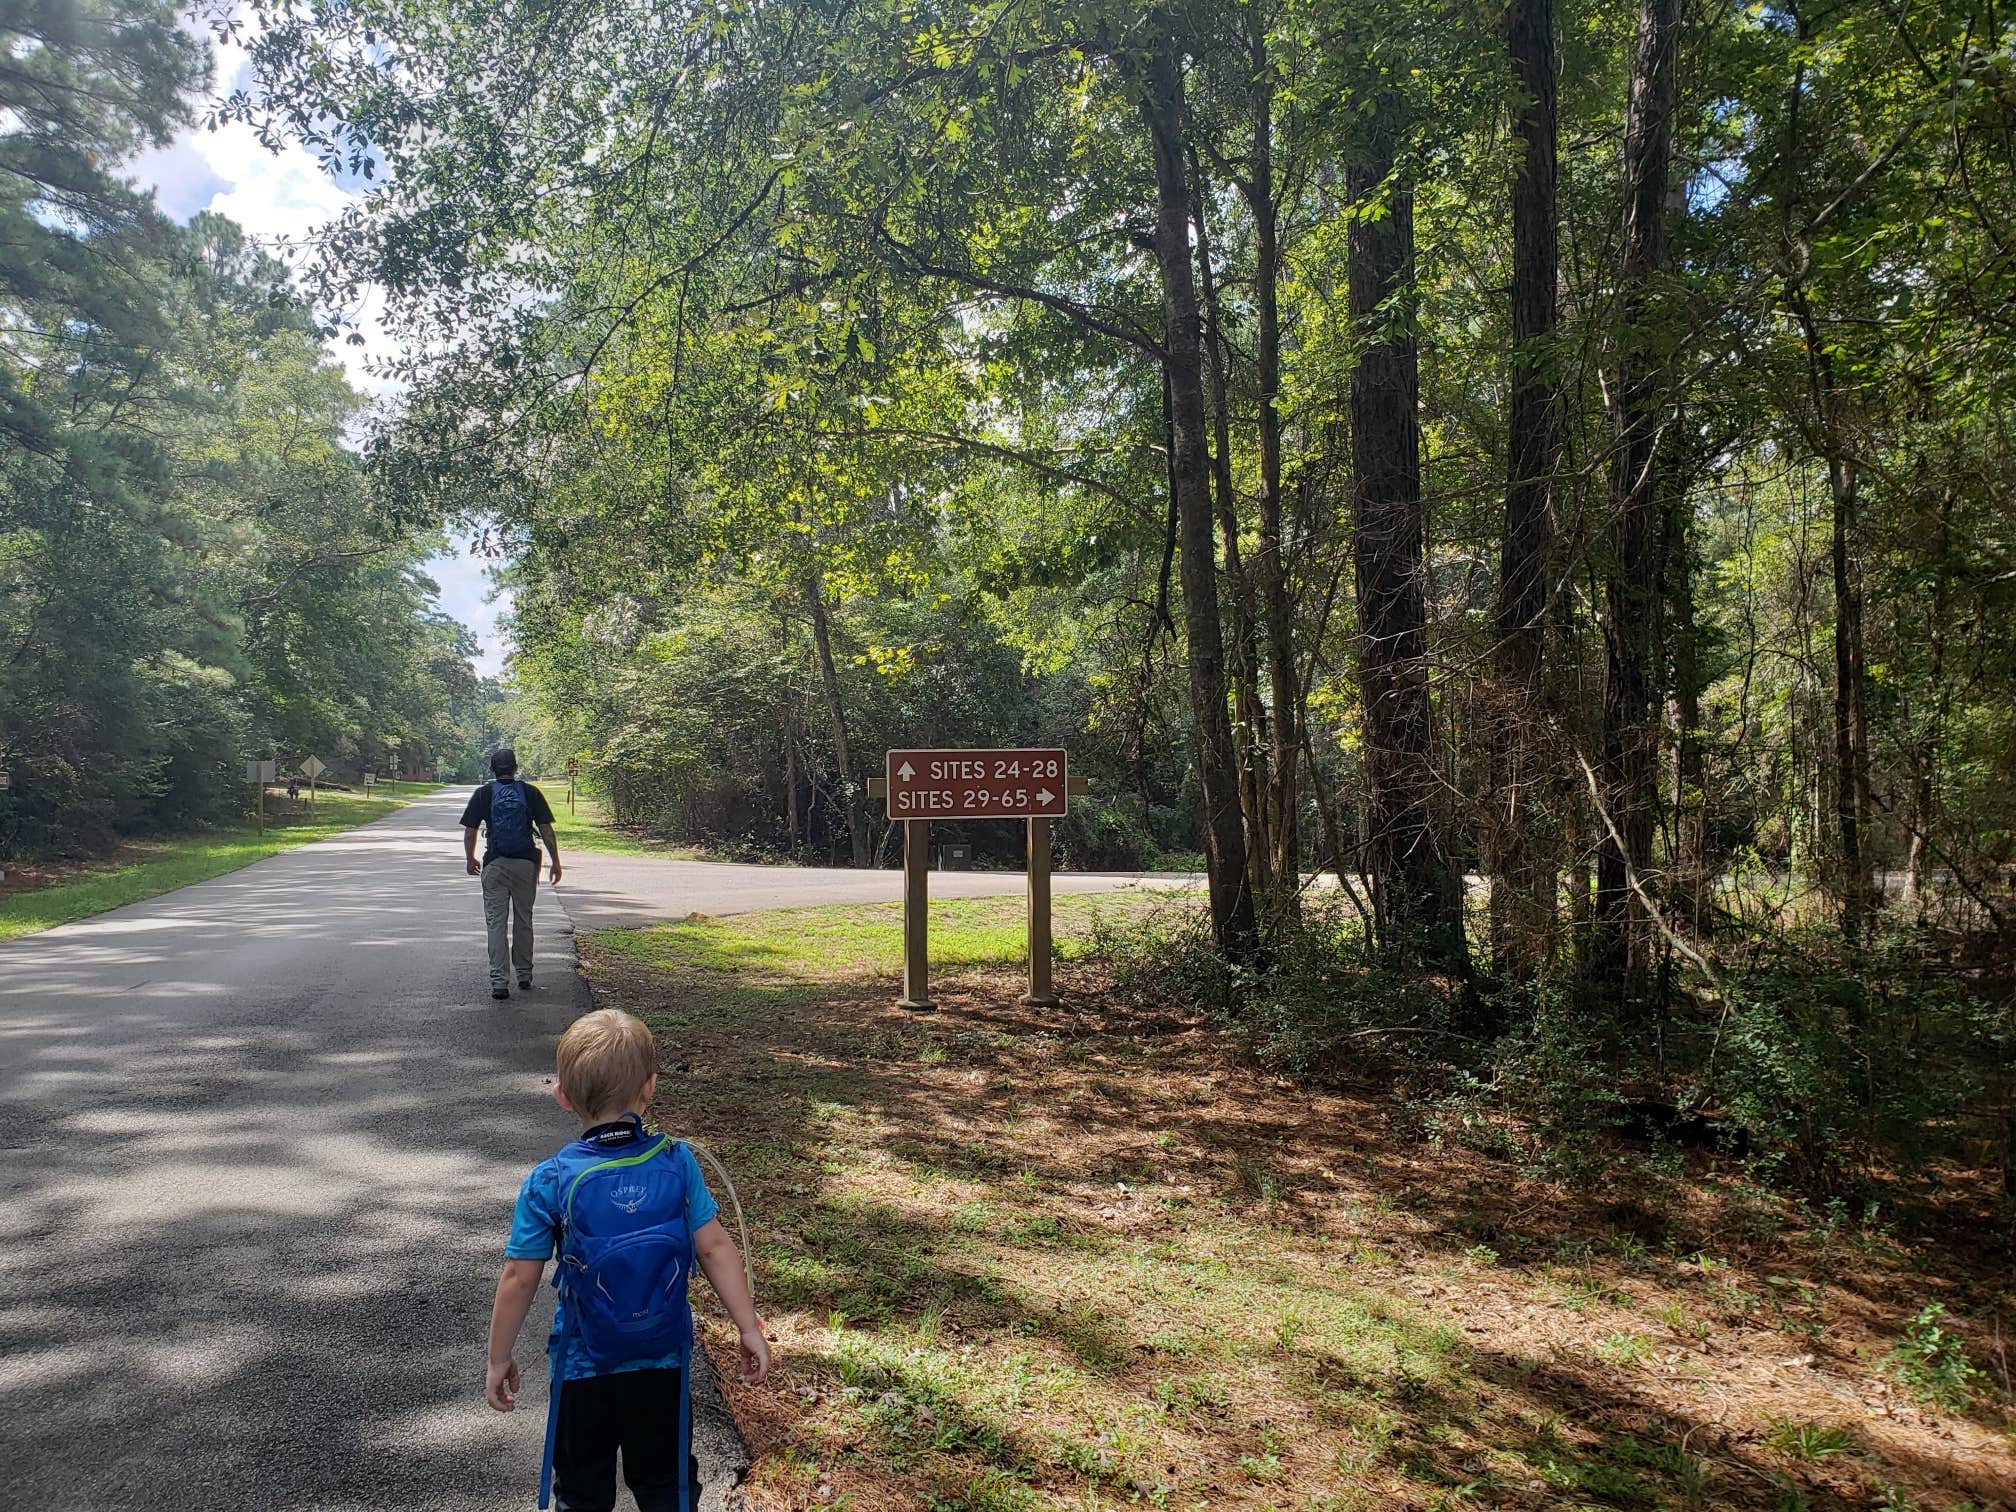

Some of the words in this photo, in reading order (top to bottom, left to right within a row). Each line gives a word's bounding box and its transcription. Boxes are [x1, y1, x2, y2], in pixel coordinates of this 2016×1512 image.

[930, 761, 985, 780] SITES
[994, 760, 1058, 779] 24-28
[898, 790, 954, 810] SITES
[963, 789, 1028, 808] 29-65
[610, 1185, 647, 1197] OSPREY
